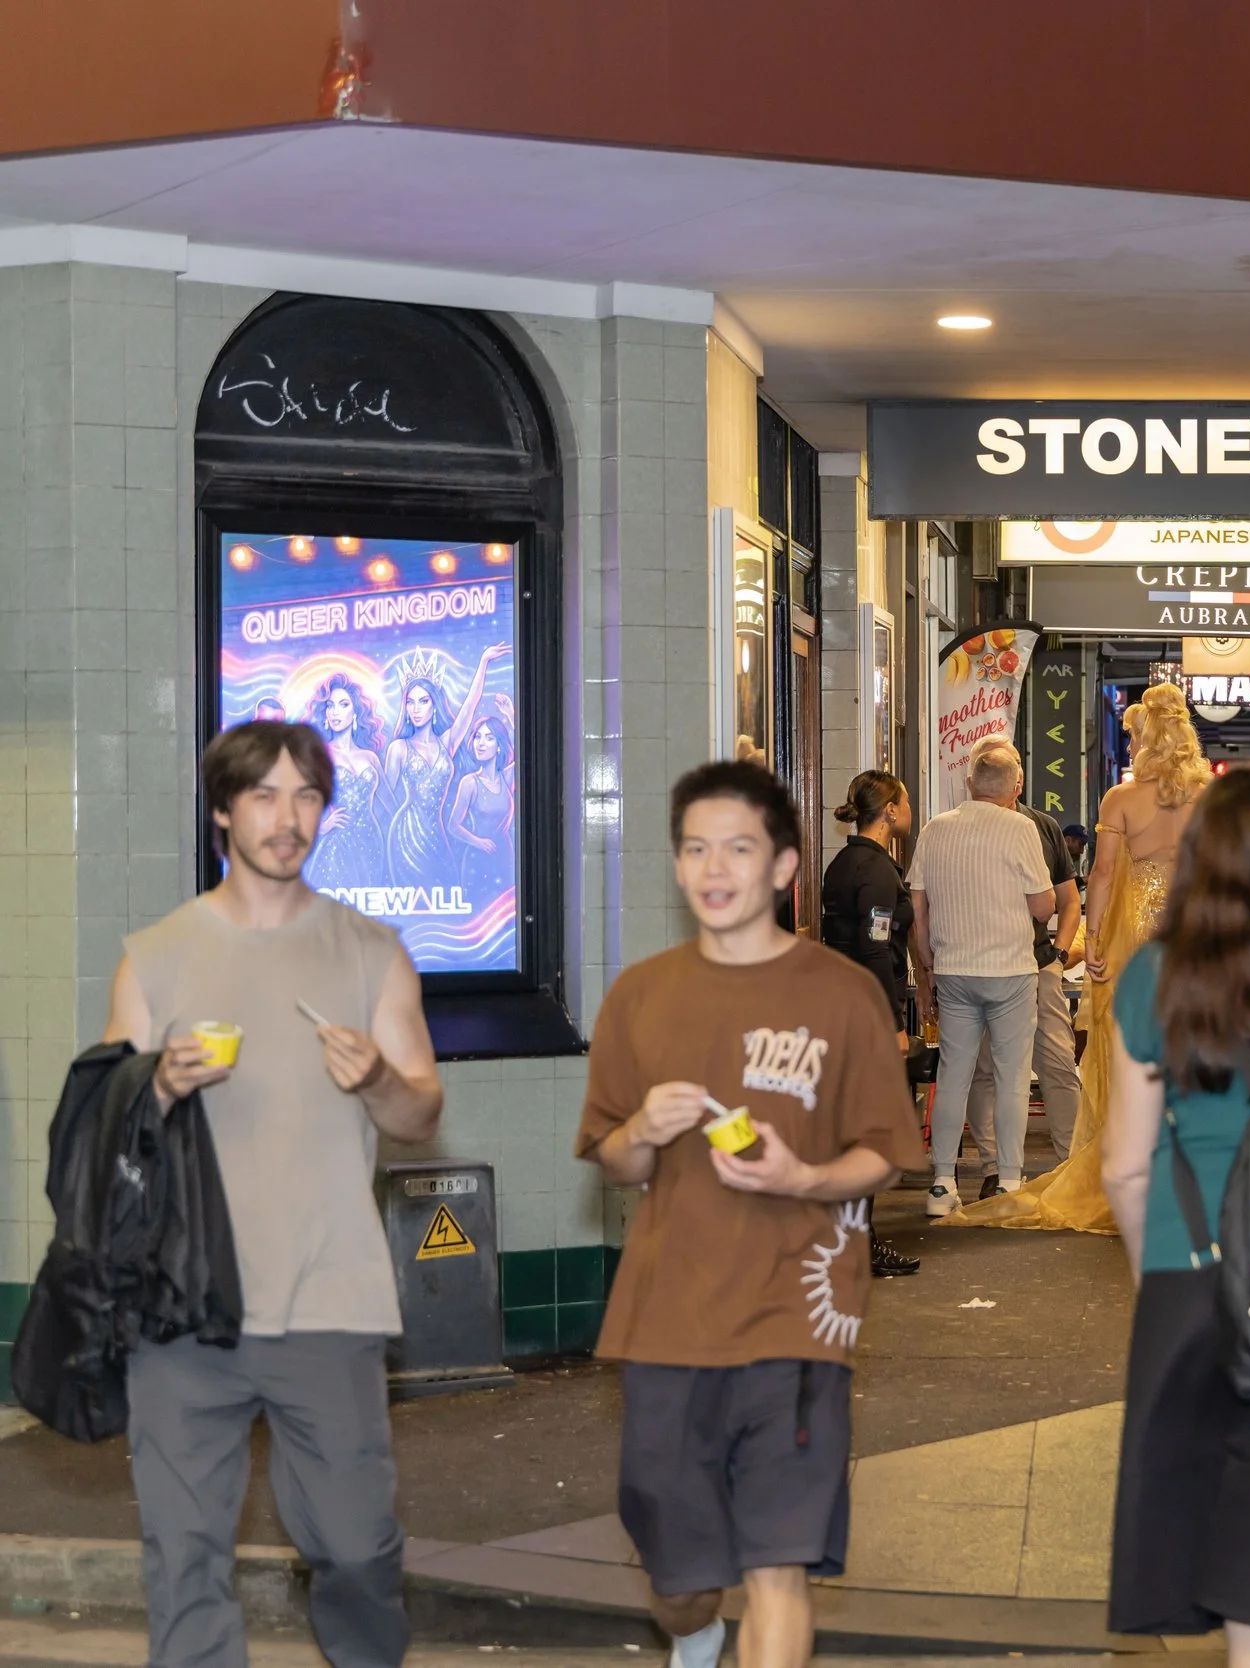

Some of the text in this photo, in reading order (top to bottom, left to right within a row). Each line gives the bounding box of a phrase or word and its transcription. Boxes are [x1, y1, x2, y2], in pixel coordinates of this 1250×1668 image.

[242, 585, 497, 643] QUEER KINGDOM
[1043, 664, 1073, 677] MR
[939, 687, 1013, 734] moothies
[947, 755, 970, 771] in-sto
